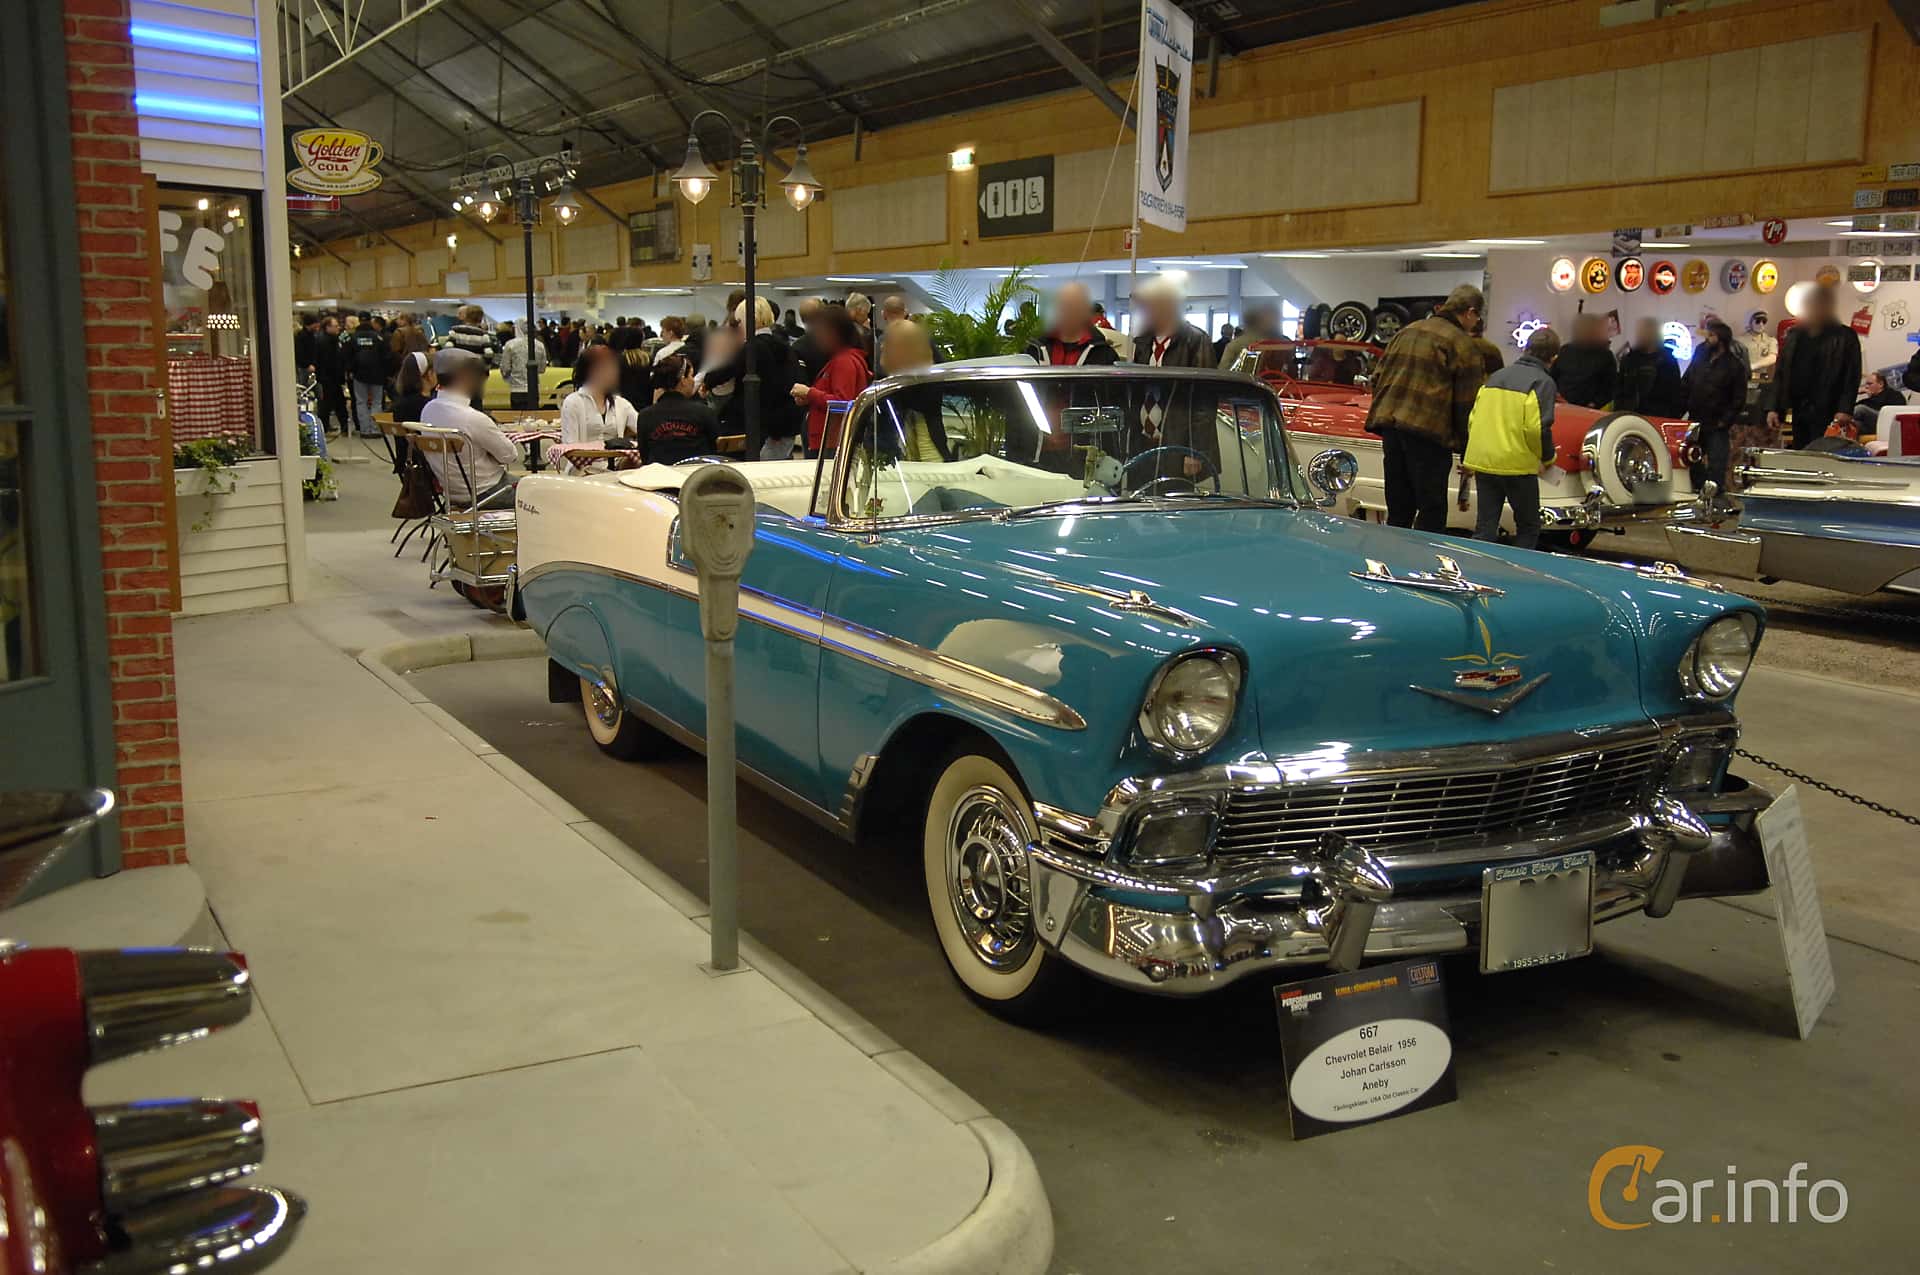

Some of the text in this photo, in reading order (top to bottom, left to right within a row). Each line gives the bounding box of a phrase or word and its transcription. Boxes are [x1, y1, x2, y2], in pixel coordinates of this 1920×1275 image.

[308, 135, 360, 167] Golden
[317, 163, 349, 171] COLA
[1890, 315, 1905, 329] 66
[1359, 1025, 1378, 1040] 667
[1325, 1037, 1417, 1066] Chevrolet Belair 1956
[1340, 1057, 1406, 1080] Johan Carlsson
[1362, 1078, 1389, 1092] Aneby
